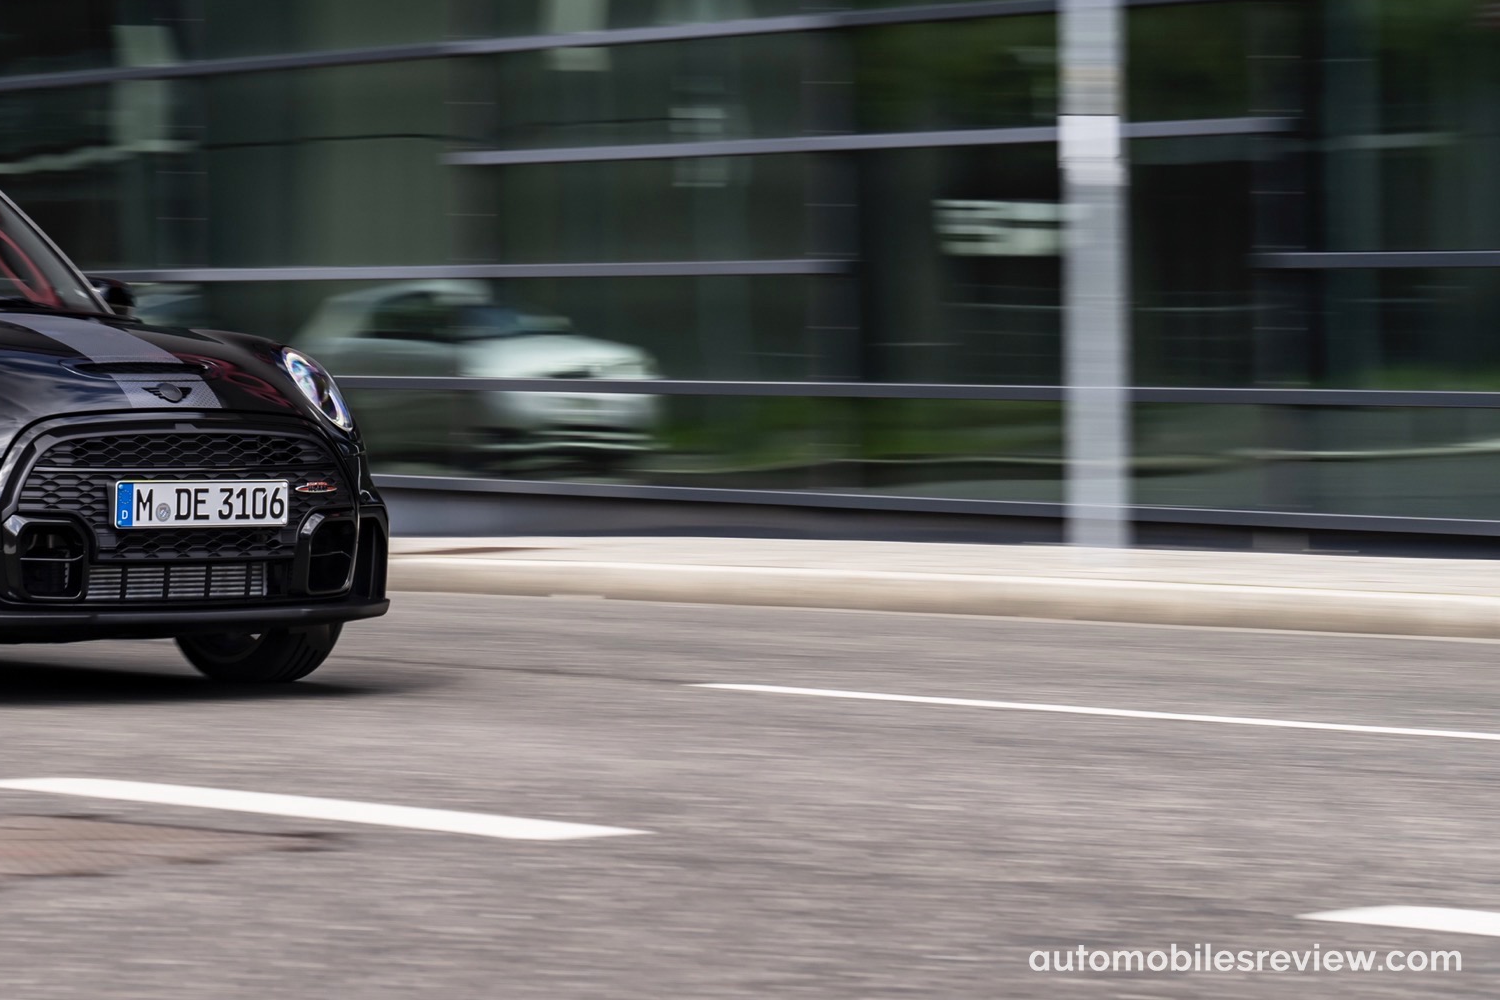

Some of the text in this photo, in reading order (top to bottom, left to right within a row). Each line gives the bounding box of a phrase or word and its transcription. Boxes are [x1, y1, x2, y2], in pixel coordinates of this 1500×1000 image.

[121, 510, 129, 520] D
[136, 487, 285, 521] M DE 3106
